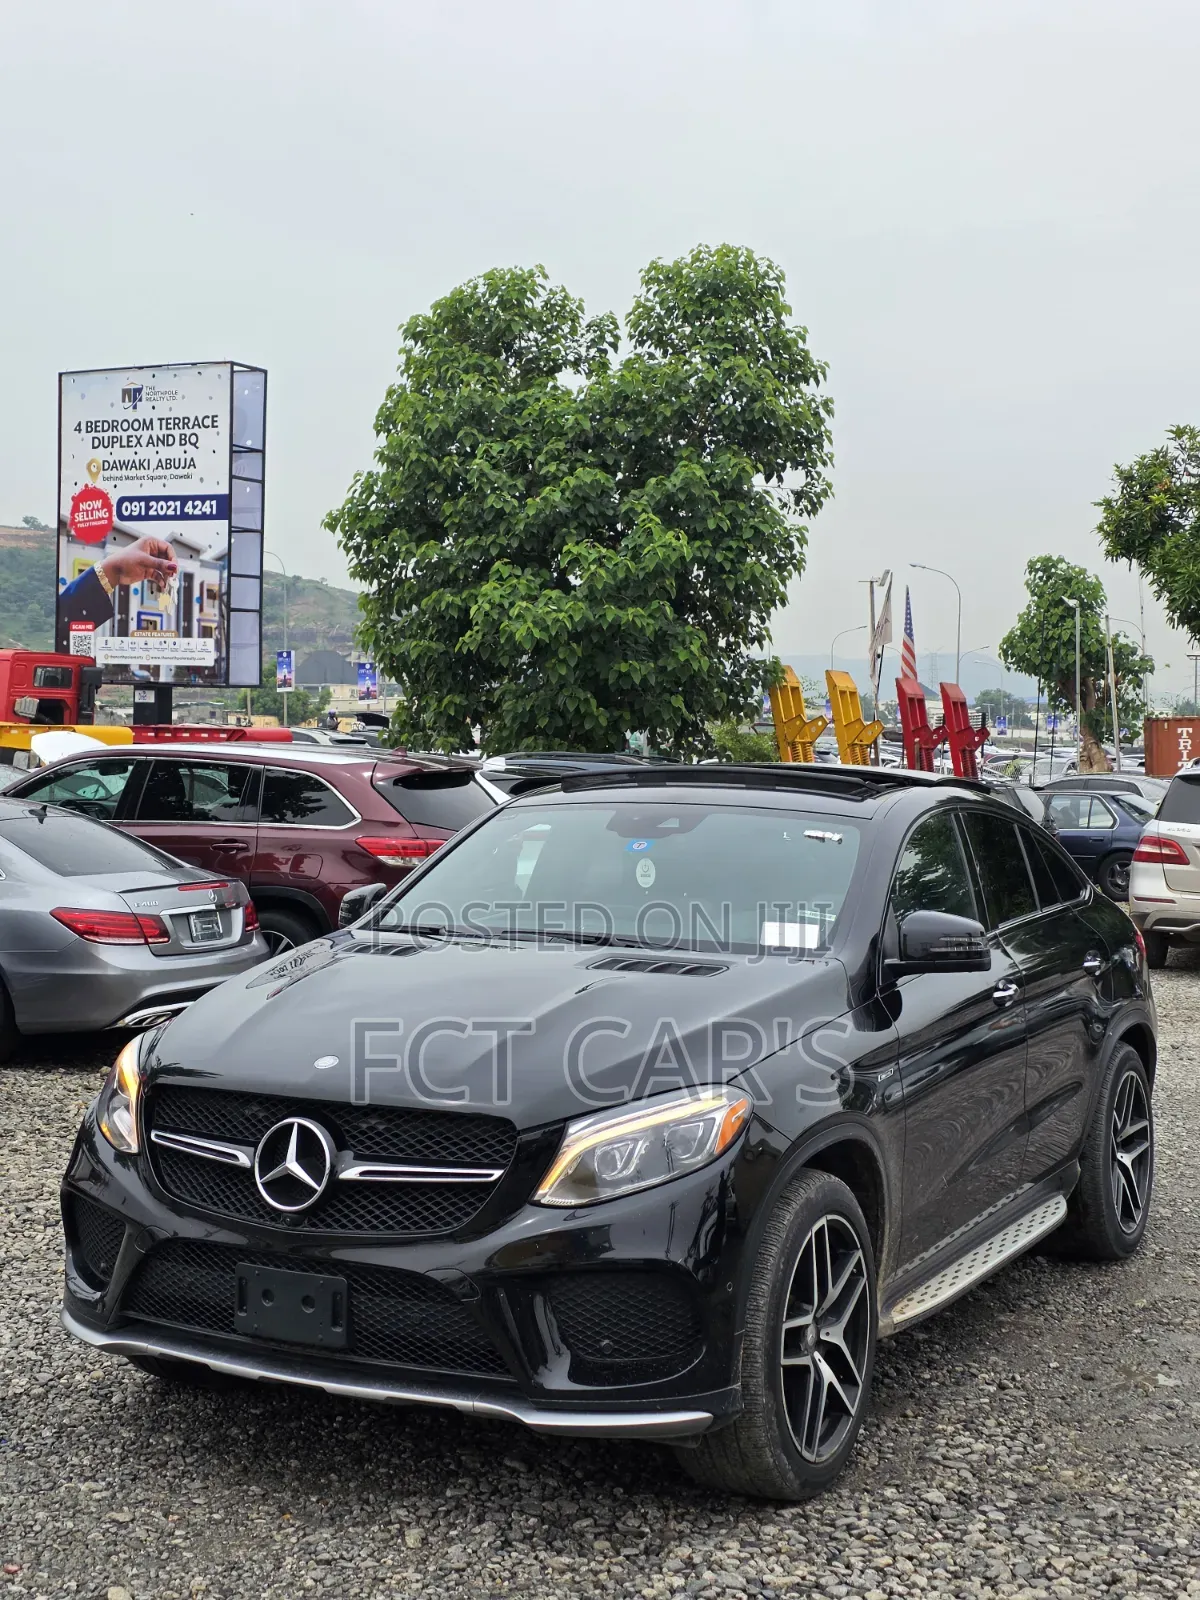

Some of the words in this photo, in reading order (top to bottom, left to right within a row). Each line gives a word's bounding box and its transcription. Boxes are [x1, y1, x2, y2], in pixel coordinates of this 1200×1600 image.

[145, 389, 178, 397] NORTHPOLE
[74, 421, 82, 434] 4
[86, 418, 154, 434] BEDROOM
[157, 415, 219, 431] TERRACE
[91, 434, 143, 450] DUPLEX
[146, 433, 176, 448] AND
[179, 432, 200, 449] BQ
[102, 459, 150, 471] DAWAKI
[102, 474, 124, 482] behind
[169, 473, 193, 481] Dawaki
[79, 499, 103, 512] NOW
[121, 501, 145, 516] 091
[149, 500, 181, 516] 2021
[184, 499, 217, 515] 4241
[74, 508, 109, 523] SELLING
